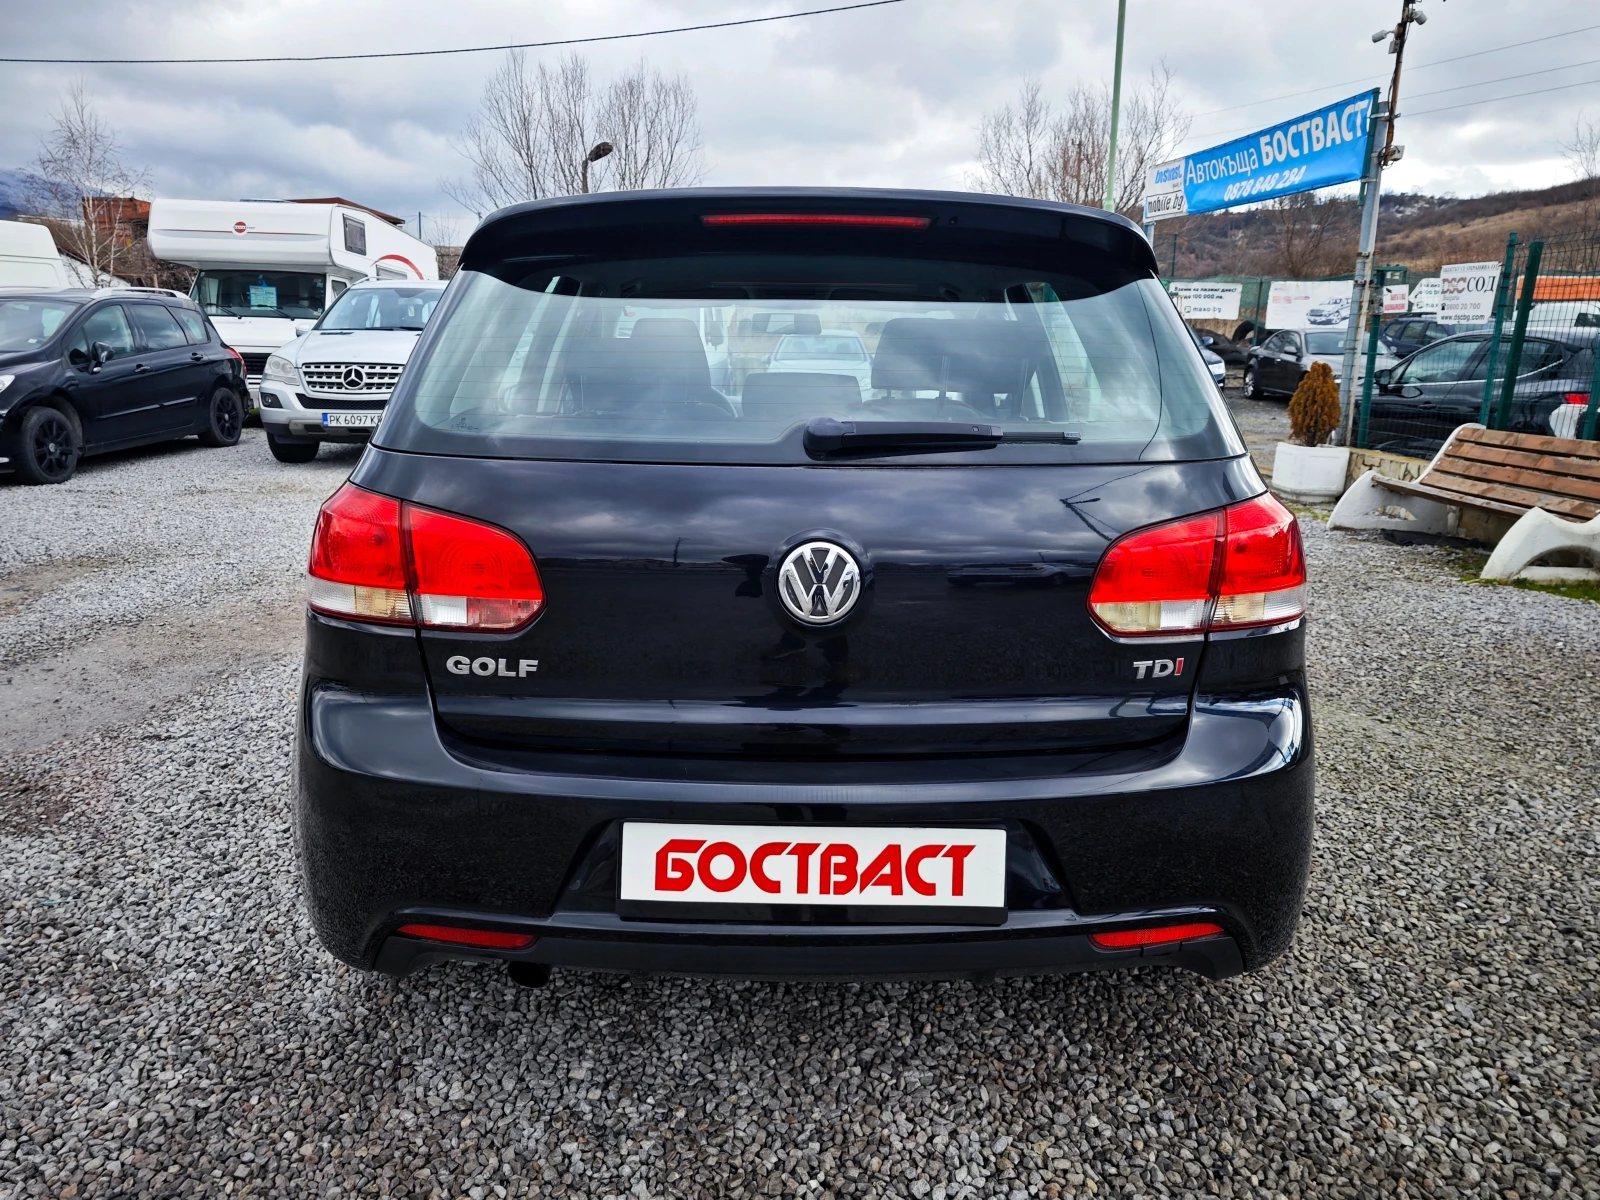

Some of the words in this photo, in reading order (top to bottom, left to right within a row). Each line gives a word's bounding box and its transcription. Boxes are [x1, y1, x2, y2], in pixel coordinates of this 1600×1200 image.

[1186, 148, 1258, 187] Автокъща
[1260, 100, 1368, 167] БОСТВАСТ
[1224, 179, 1254, 201] 0878
[1251, 173, 1280, 195] 848
[1275, 165, 1307, 189] 284
[1467, 276, 1497, 293] СОД
[329, 415, 341, 425] PK
[344, 415, 368, 425] 6097
[446, 655, 539, 678] GOLF
[1133, 657, 1185, 679] TDI
[655, 839, 977, 897] БОСТВАСТ
